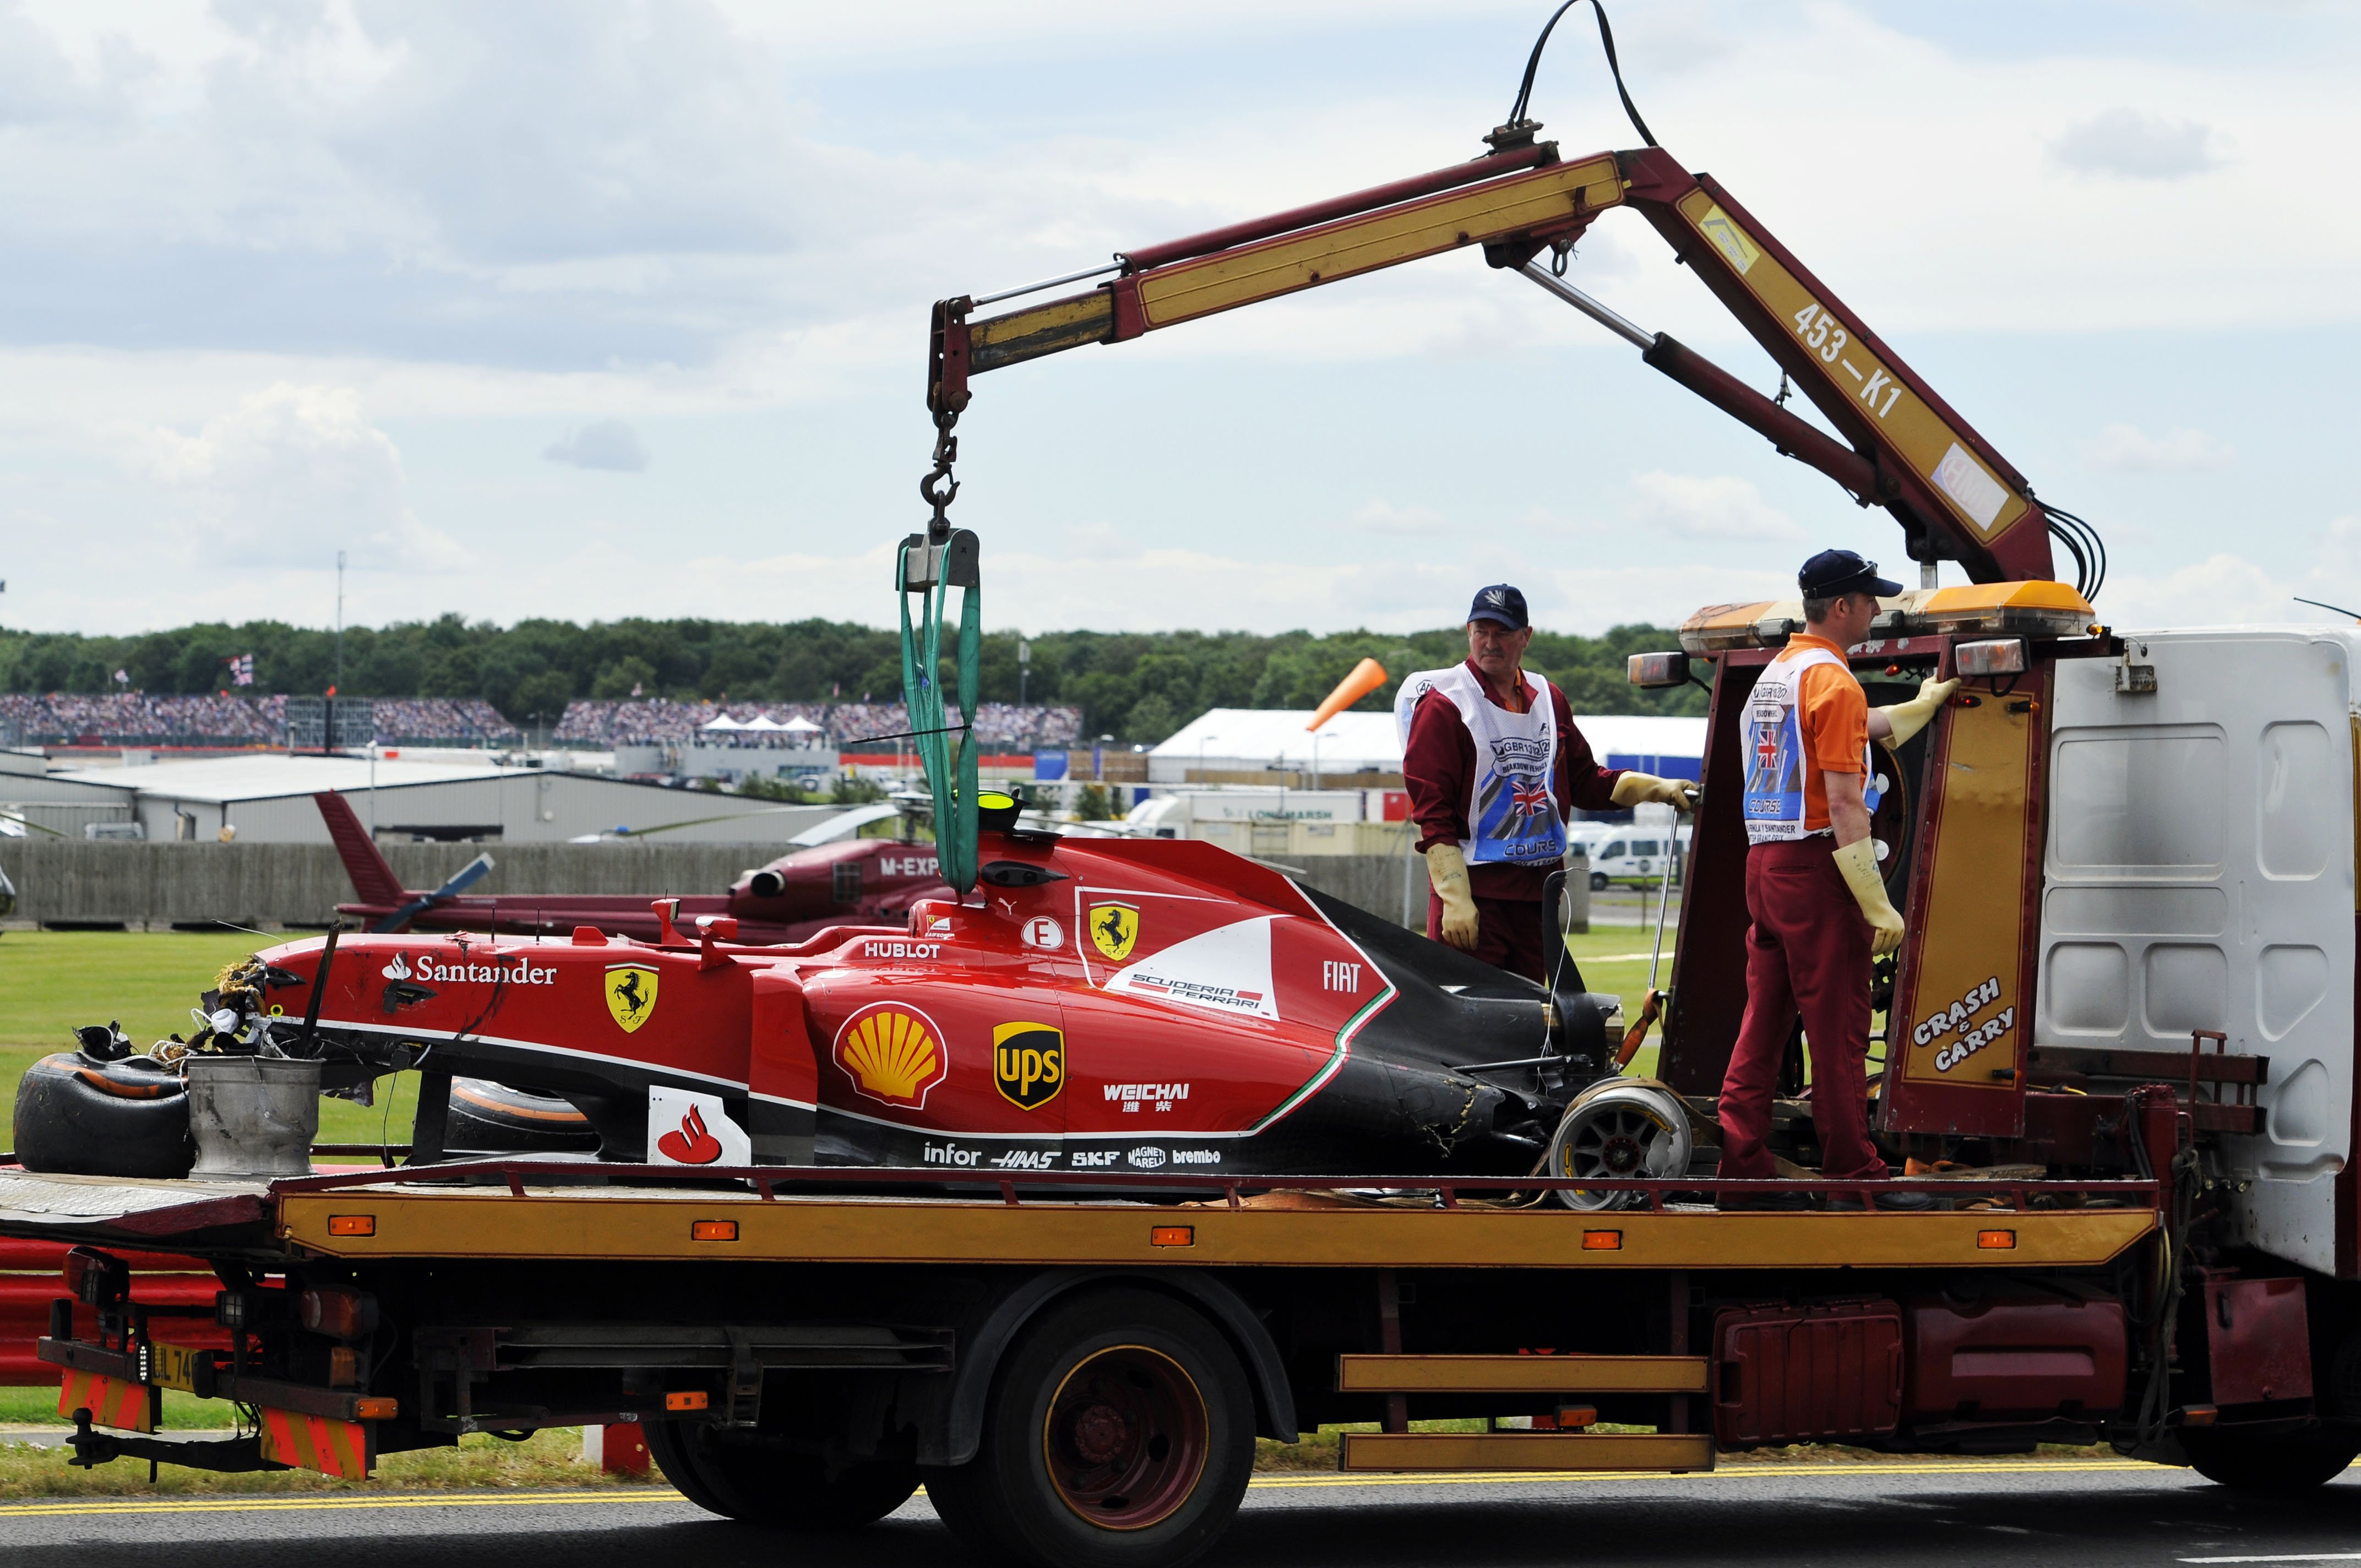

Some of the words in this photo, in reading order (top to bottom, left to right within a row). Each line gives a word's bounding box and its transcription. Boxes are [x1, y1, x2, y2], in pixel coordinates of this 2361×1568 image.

[1504, 839, 1558, 857] COURS
[881, 857, 939, 876] M-EXP
[1034, 921, 1051, 946] E
[864, 943, 940, 959] HUBLOT
[416, 956, 557, 984] Santander
[1323, 960, 1361, 993] FIAT
[1131, 973, 1234, 997] SCUDERIA
[1171, 989, 1259, 1009] FERRARI
[1913, 977, 2000, 1045] CRASH
[1935, 1006, 2014, 1070] CARRY
[1959, 1021, 1971, 1033] &
[999, 1048, 1059, 1096] ups
[1103, 1083, 1189, 1101] WEICHAI
[924, 1141, 982, 1166] infor
[990, 1150, 1062, 1169] HAAS
[1071, 1151, 1120, 1166] SKF
[1173, 1150, 1221, 1163] brembo
[174, 1350, 191, 1385] 74
